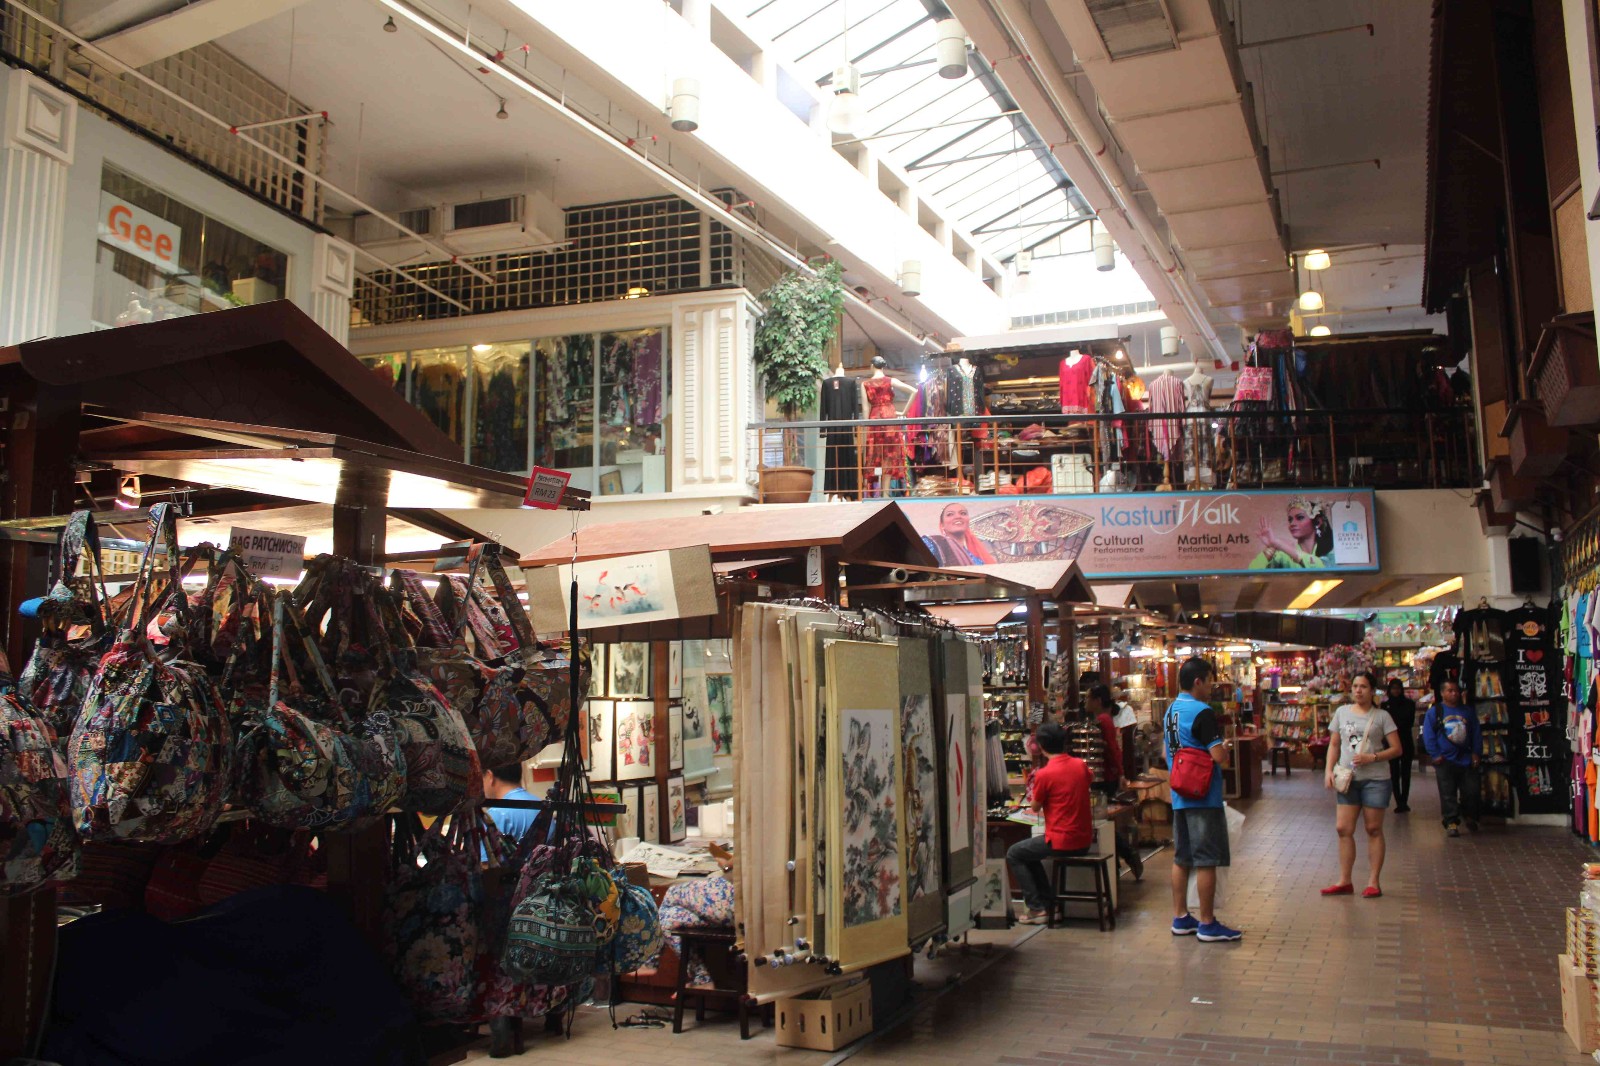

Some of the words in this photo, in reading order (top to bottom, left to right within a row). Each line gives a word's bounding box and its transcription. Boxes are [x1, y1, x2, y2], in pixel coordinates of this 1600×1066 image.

[108, 205, 173, 261] Gee
[534, 487, 547, 497] RM
[547, 490, 556, 499] 23
[1101, 505, 1177, 527] Kasturi
[1171, 495, 1245, 530] Walk
[1093, 534, 1144, 546] Cultural
[1177, 533, 1222, 545] Martial
[1226, 532, 1250, 544] Arts
[252, 536, 304, 555] PATCHWORK
[252, 560, 266, 570] RM
[1526, 745, 1553, 759] KL
